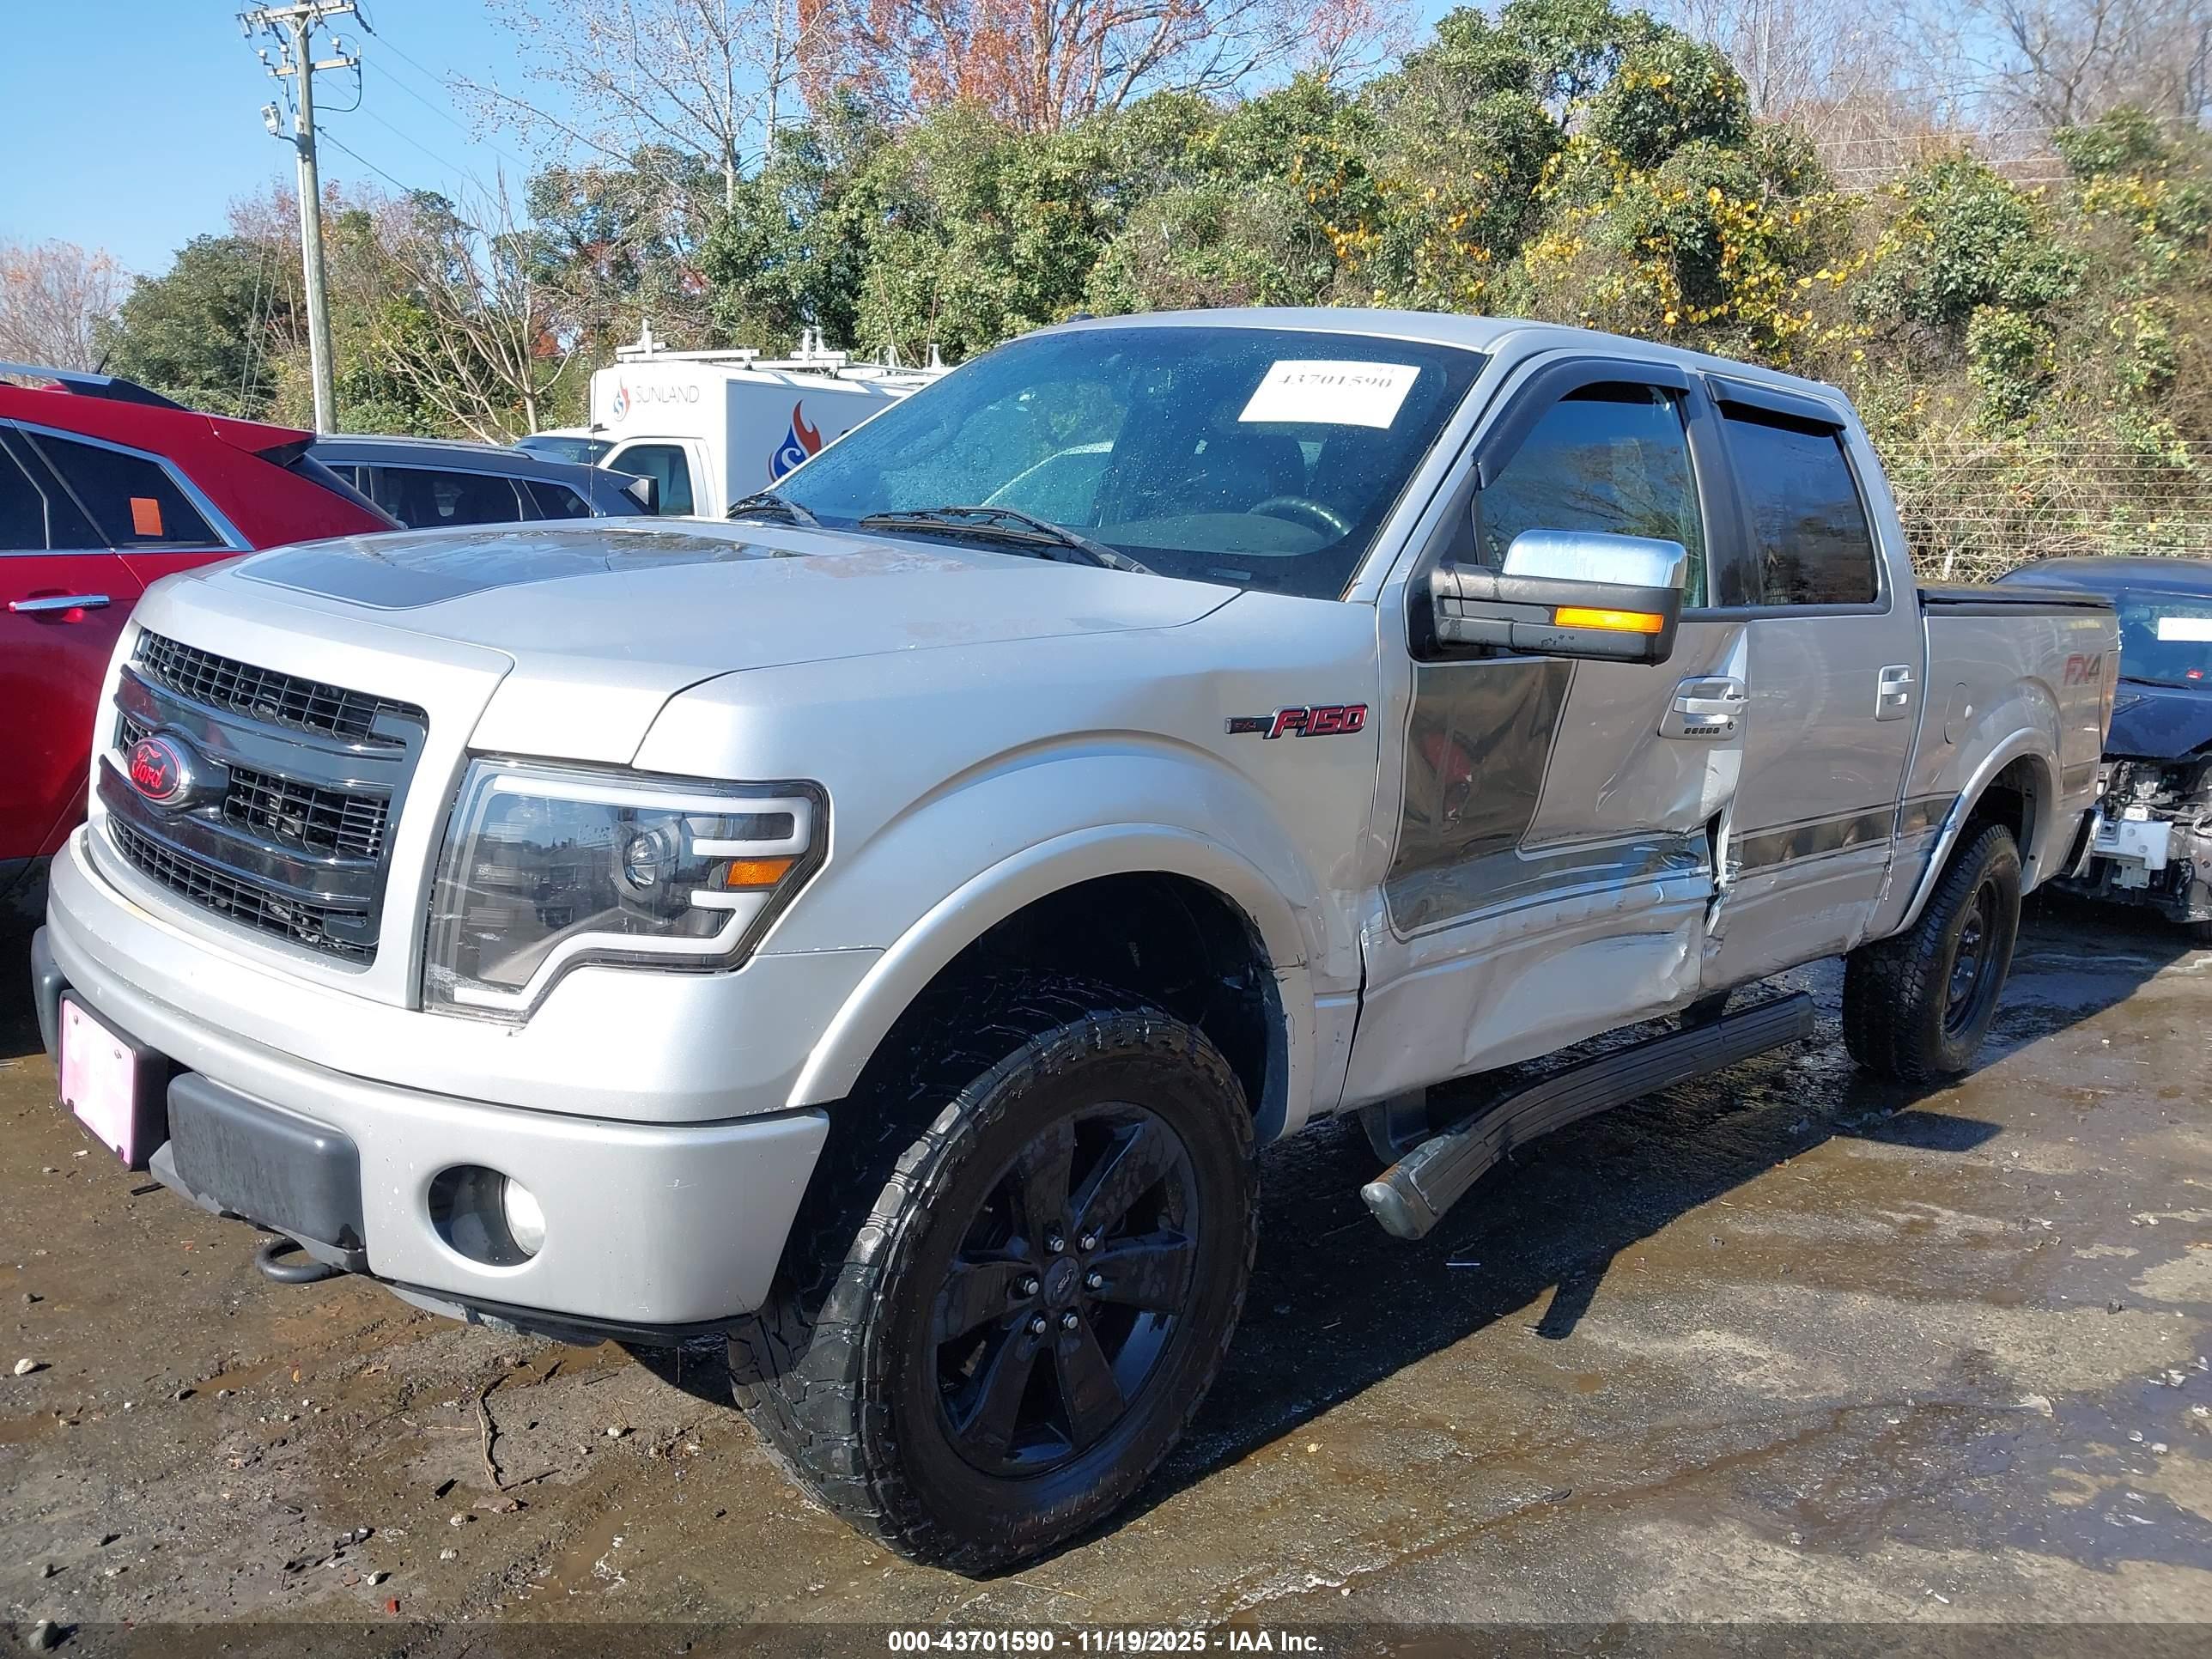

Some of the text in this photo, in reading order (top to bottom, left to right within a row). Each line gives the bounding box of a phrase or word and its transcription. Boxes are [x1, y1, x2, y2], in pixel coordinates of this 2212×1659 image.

[635, 385, 700, 404] SUNLAND
[2063, 653, 2102, 685] FX4
[131, 744, 167, 789] Ford
